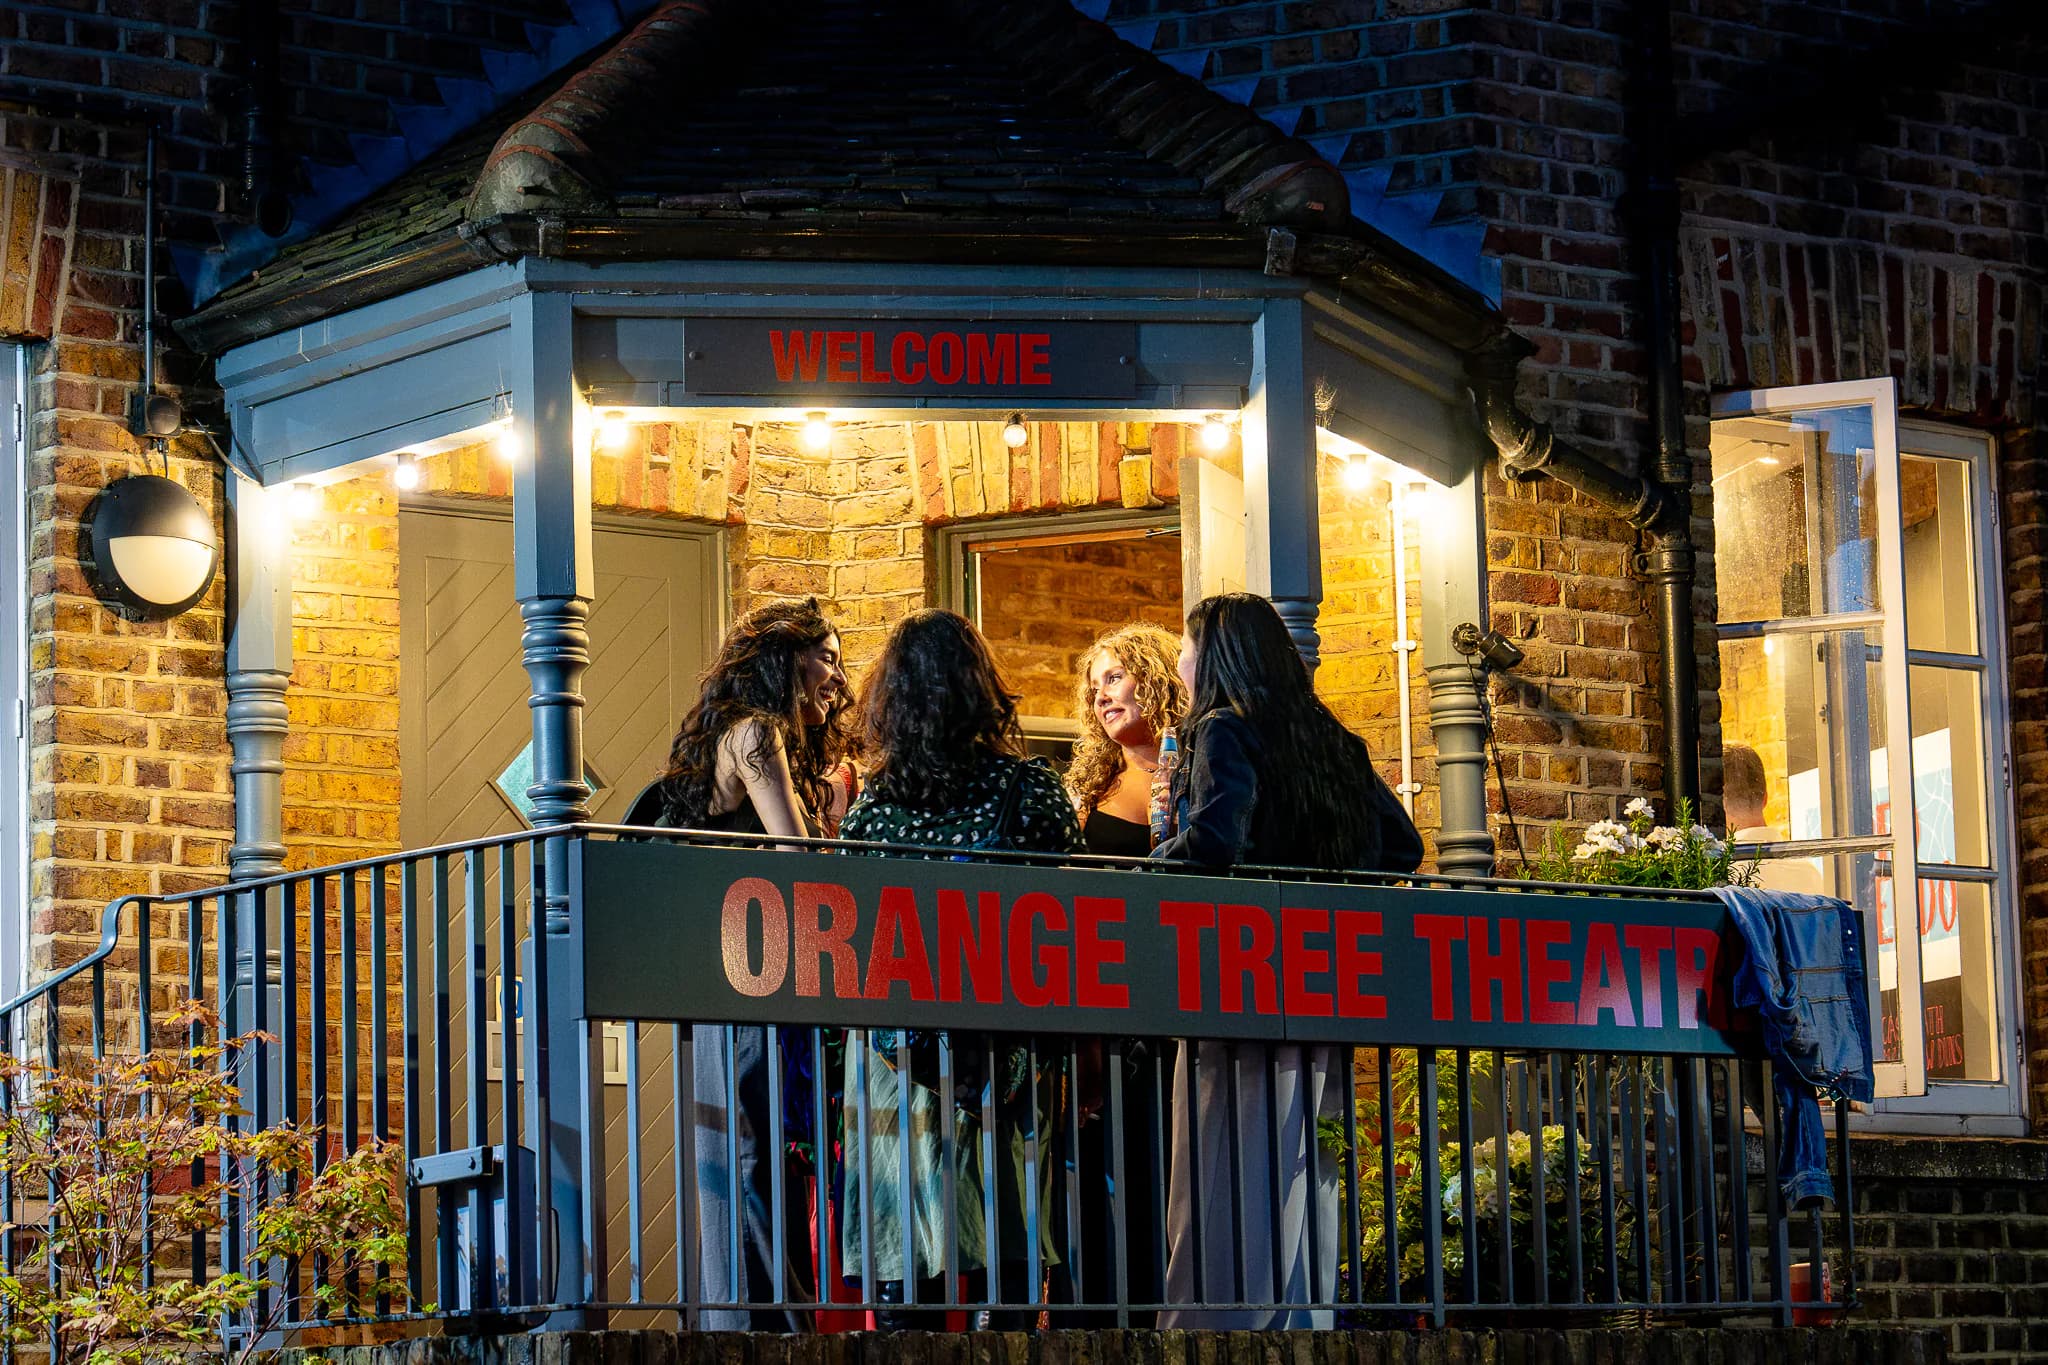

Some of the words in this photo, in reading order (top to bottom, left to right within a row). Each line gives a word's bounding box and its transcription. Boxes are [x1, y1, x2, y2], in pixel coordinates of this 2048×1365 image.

[769, 330, 1051, 384] WELCOME
[721, 876, 1130, 1008] ORANGE
[1160, 901, 1387, 1019] TREE
